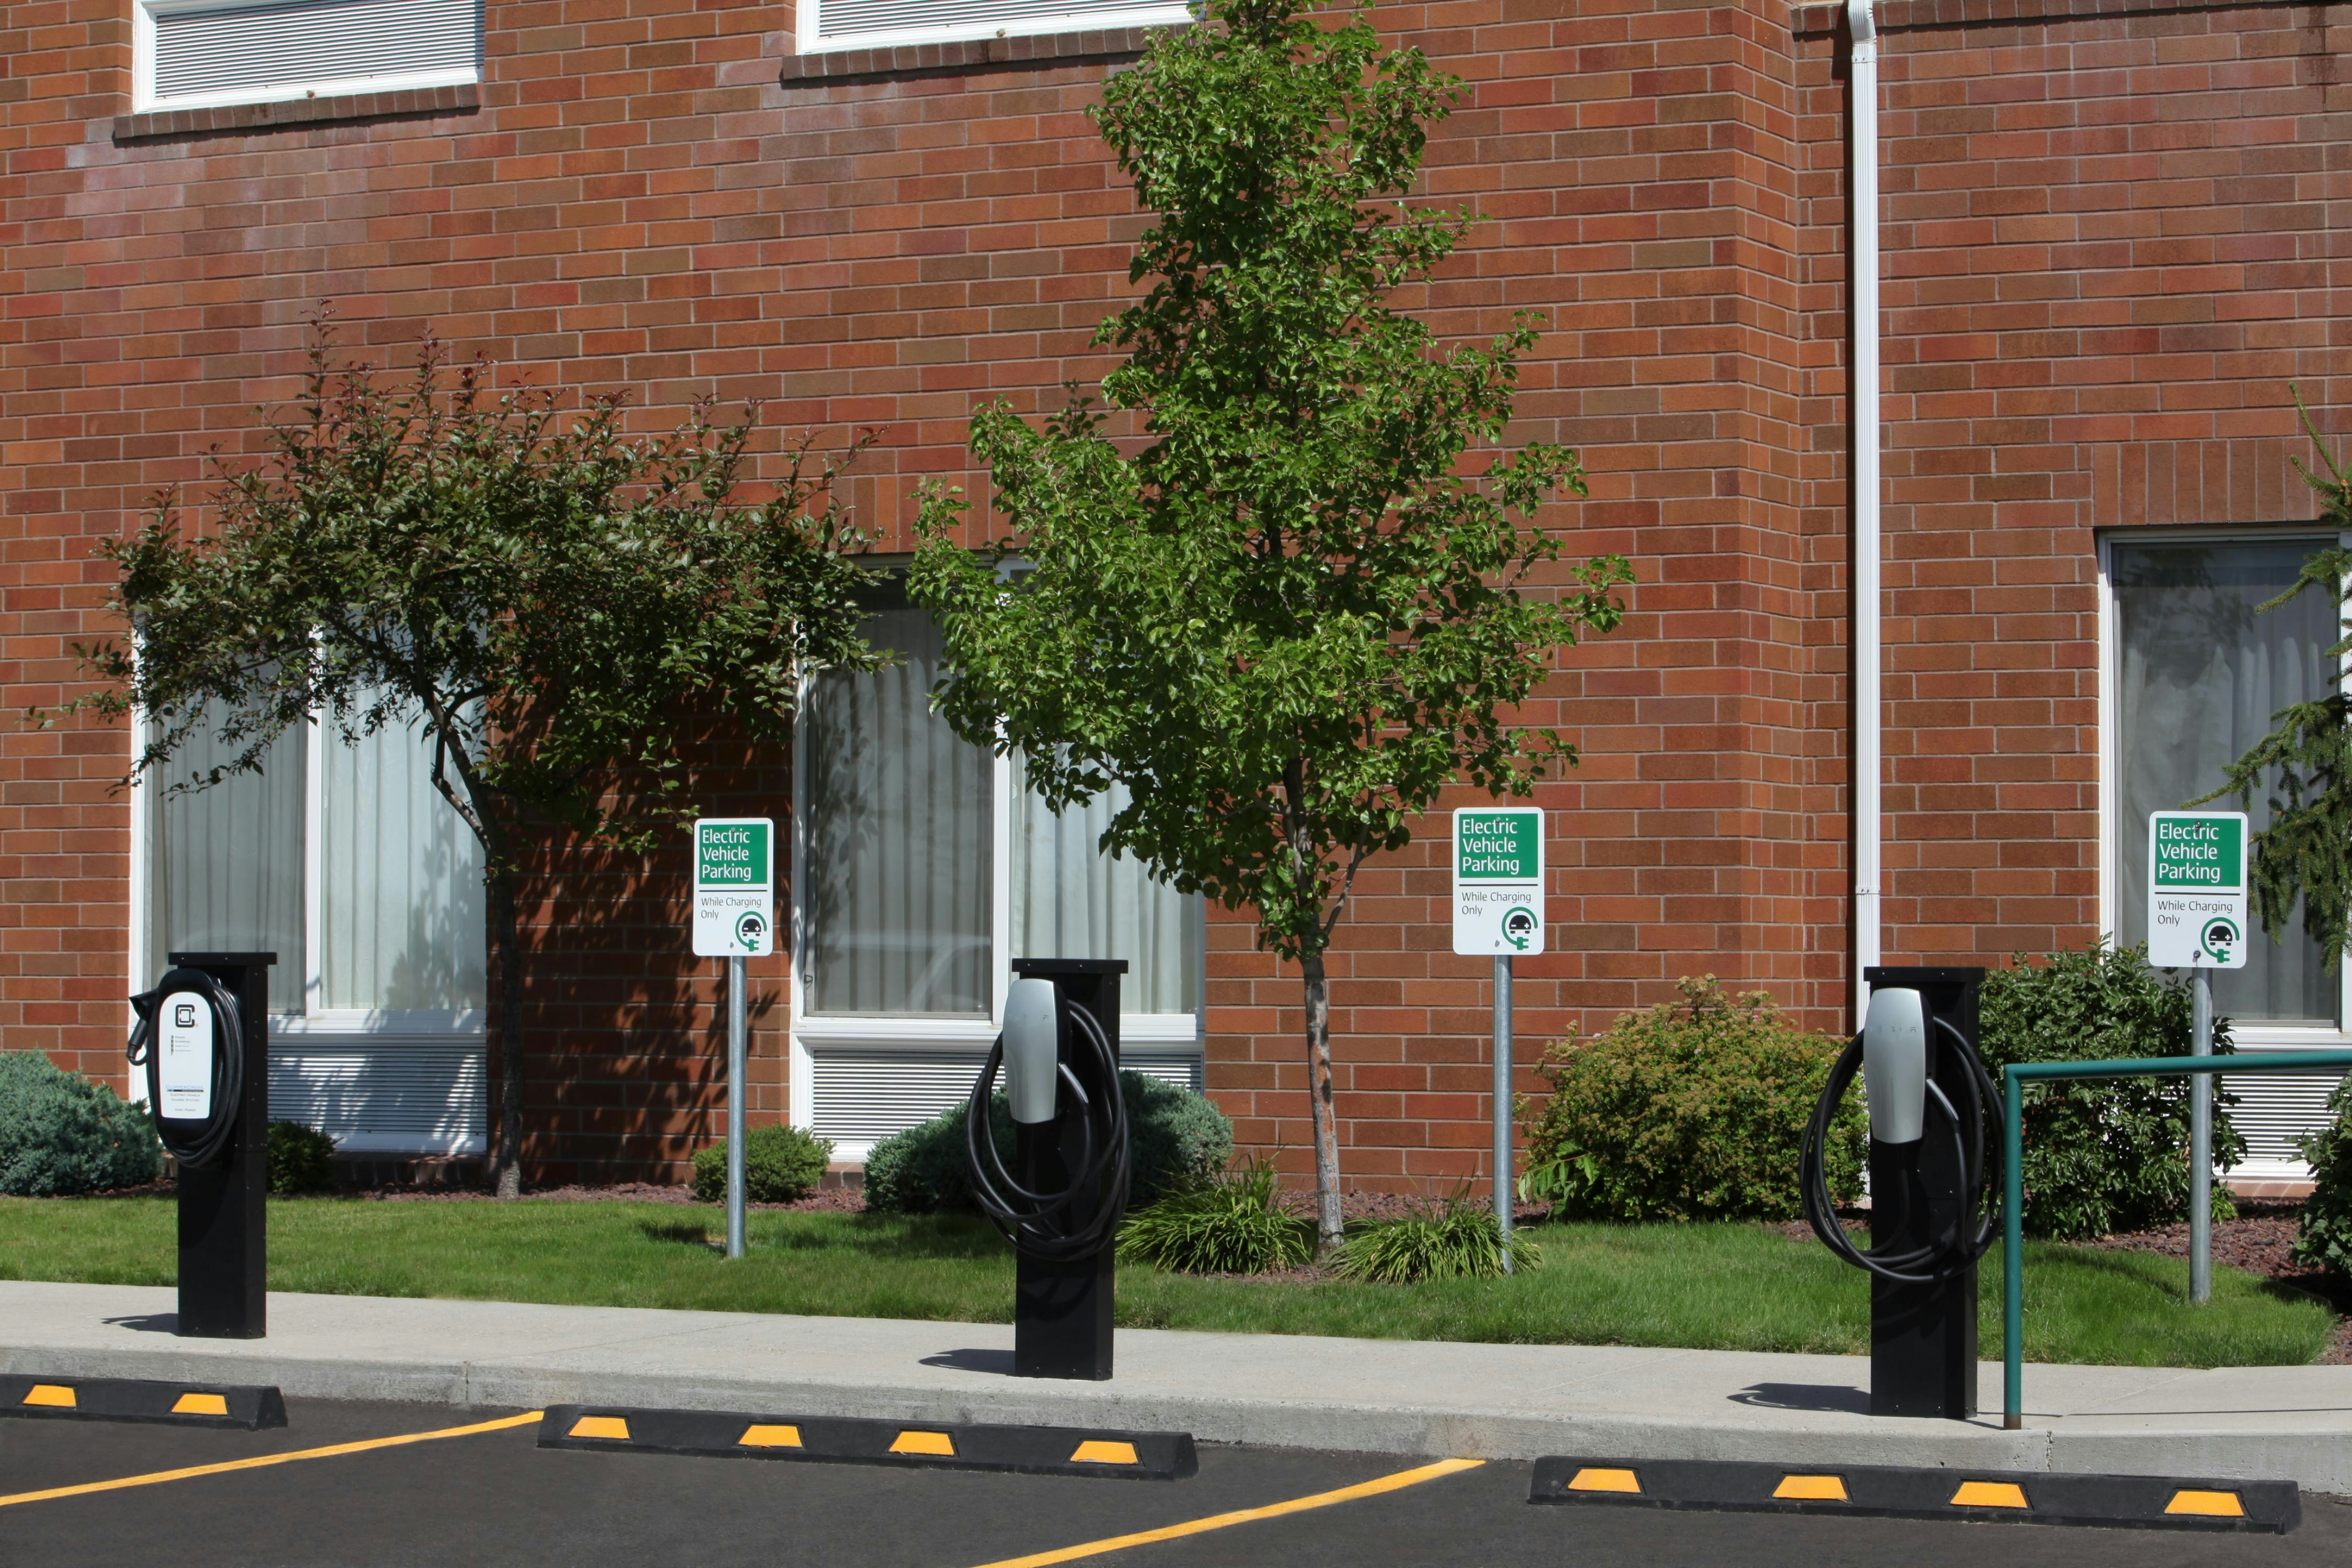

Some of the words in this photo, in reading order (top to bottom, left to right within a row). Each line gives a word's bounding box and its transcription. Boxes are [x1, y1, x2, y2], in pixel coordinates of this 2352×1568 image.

[1462, 818, 1517, 834] Electric
[2160, 823, 2219, 839] Electric
[702, 828, 750, 844] Electric
[1462, 837, 1516, 853] Vehicle
[2159, 843, 2218, 860] Vehicle
[702, 846, 749, 861] Vehicle
[702, 863, 752, 881] Parking
[1462, 856, 1519, 875] Parking
[2159, 862, 2220, 883] Parking
[701, 897, 723, 906] While
[726, 897, 762, 908] Charging
[1461, 892, 1487, 902] While
[1490, 892, 1531, 903] Charging
[701, 910, 719, 920] Only
[1461, 905, 1482, 917] Only
[2158, 900, 2185, 910] While
[2188, 901, 2233, 914] Charging
[2158, 915, 2180, 927] Only
